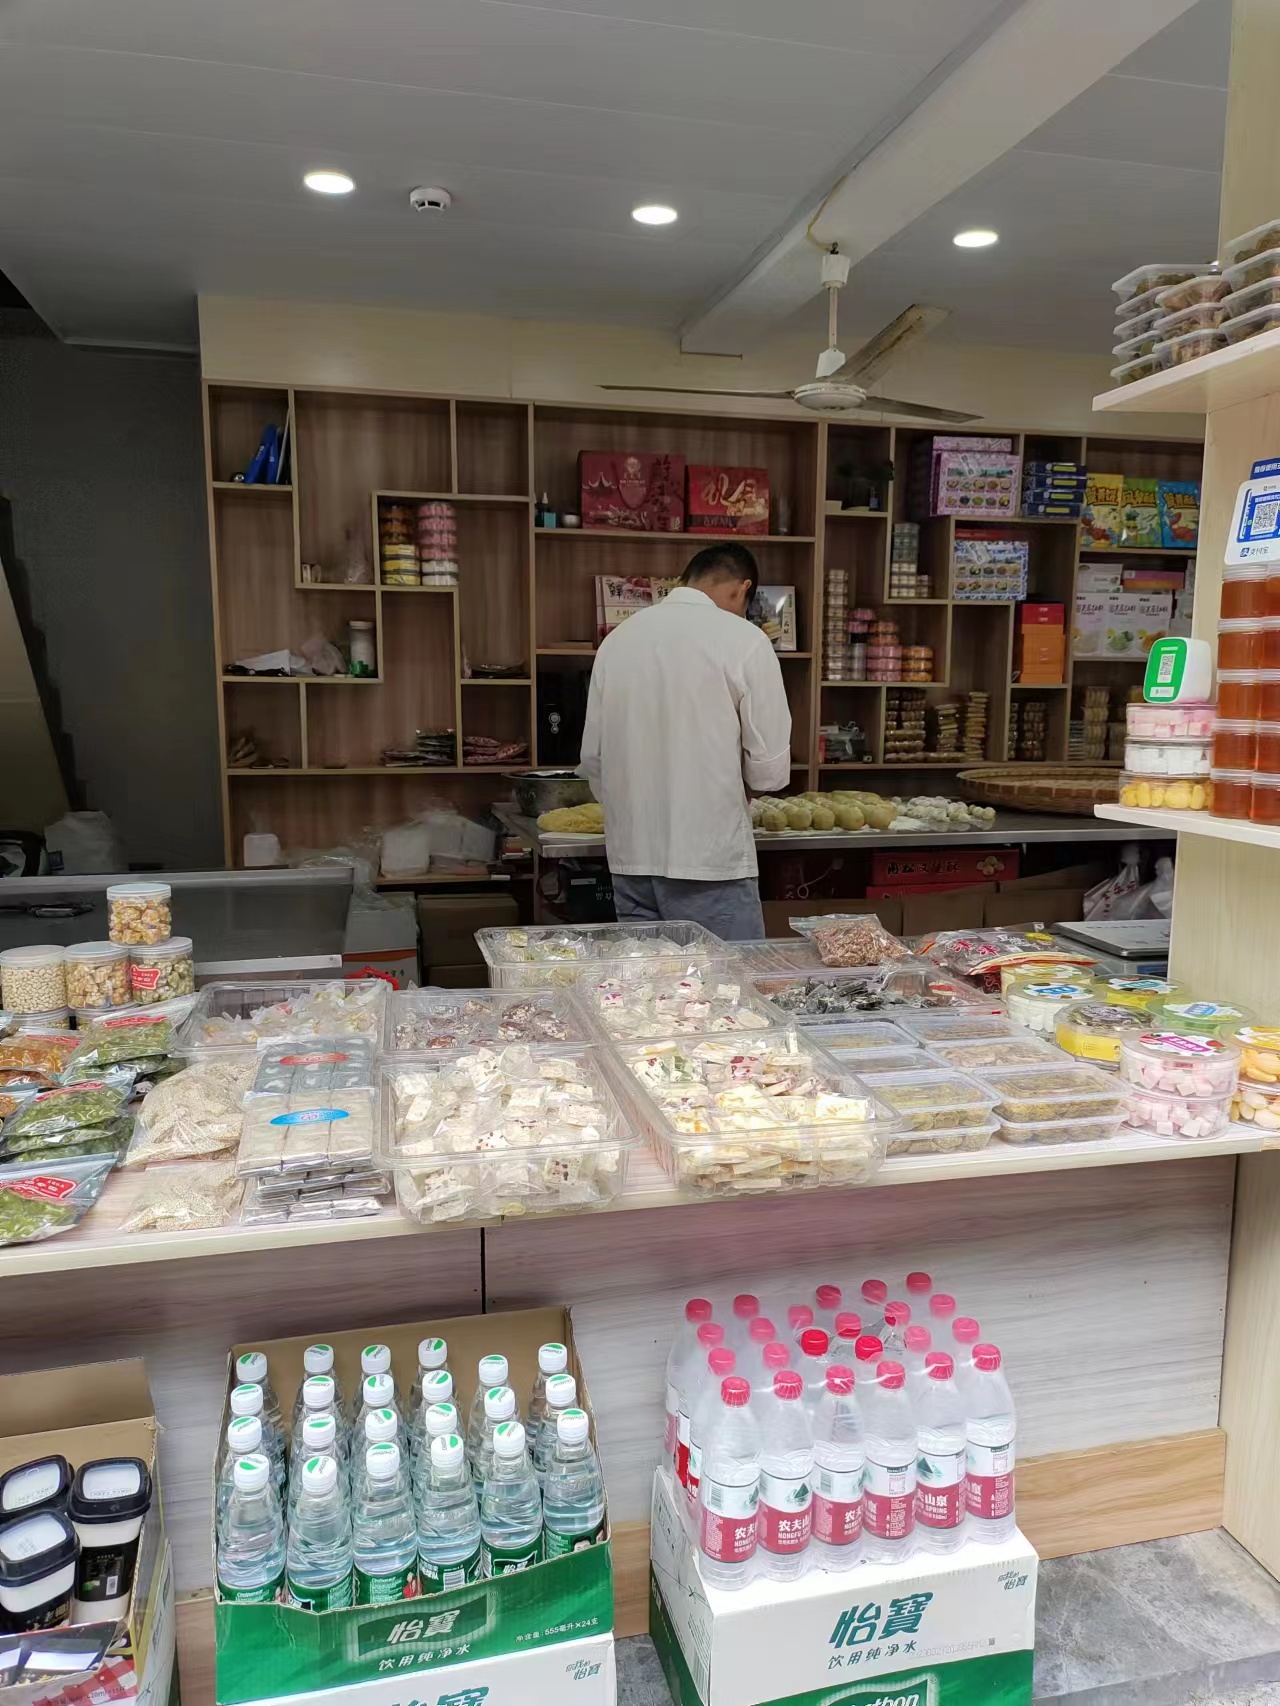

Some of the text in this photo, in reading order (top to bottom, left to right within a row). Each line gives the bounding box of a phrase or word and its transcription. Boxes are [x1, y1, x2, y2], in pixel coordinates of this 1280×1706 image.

[387, 1609, 460, 1644] 怡寶
[828, 1592, 934, 1648] 怡寶
[378, 1643, 471, 1671] 饮用纯净水
[827, 1639, 918, 1671] 饮用纯净水
